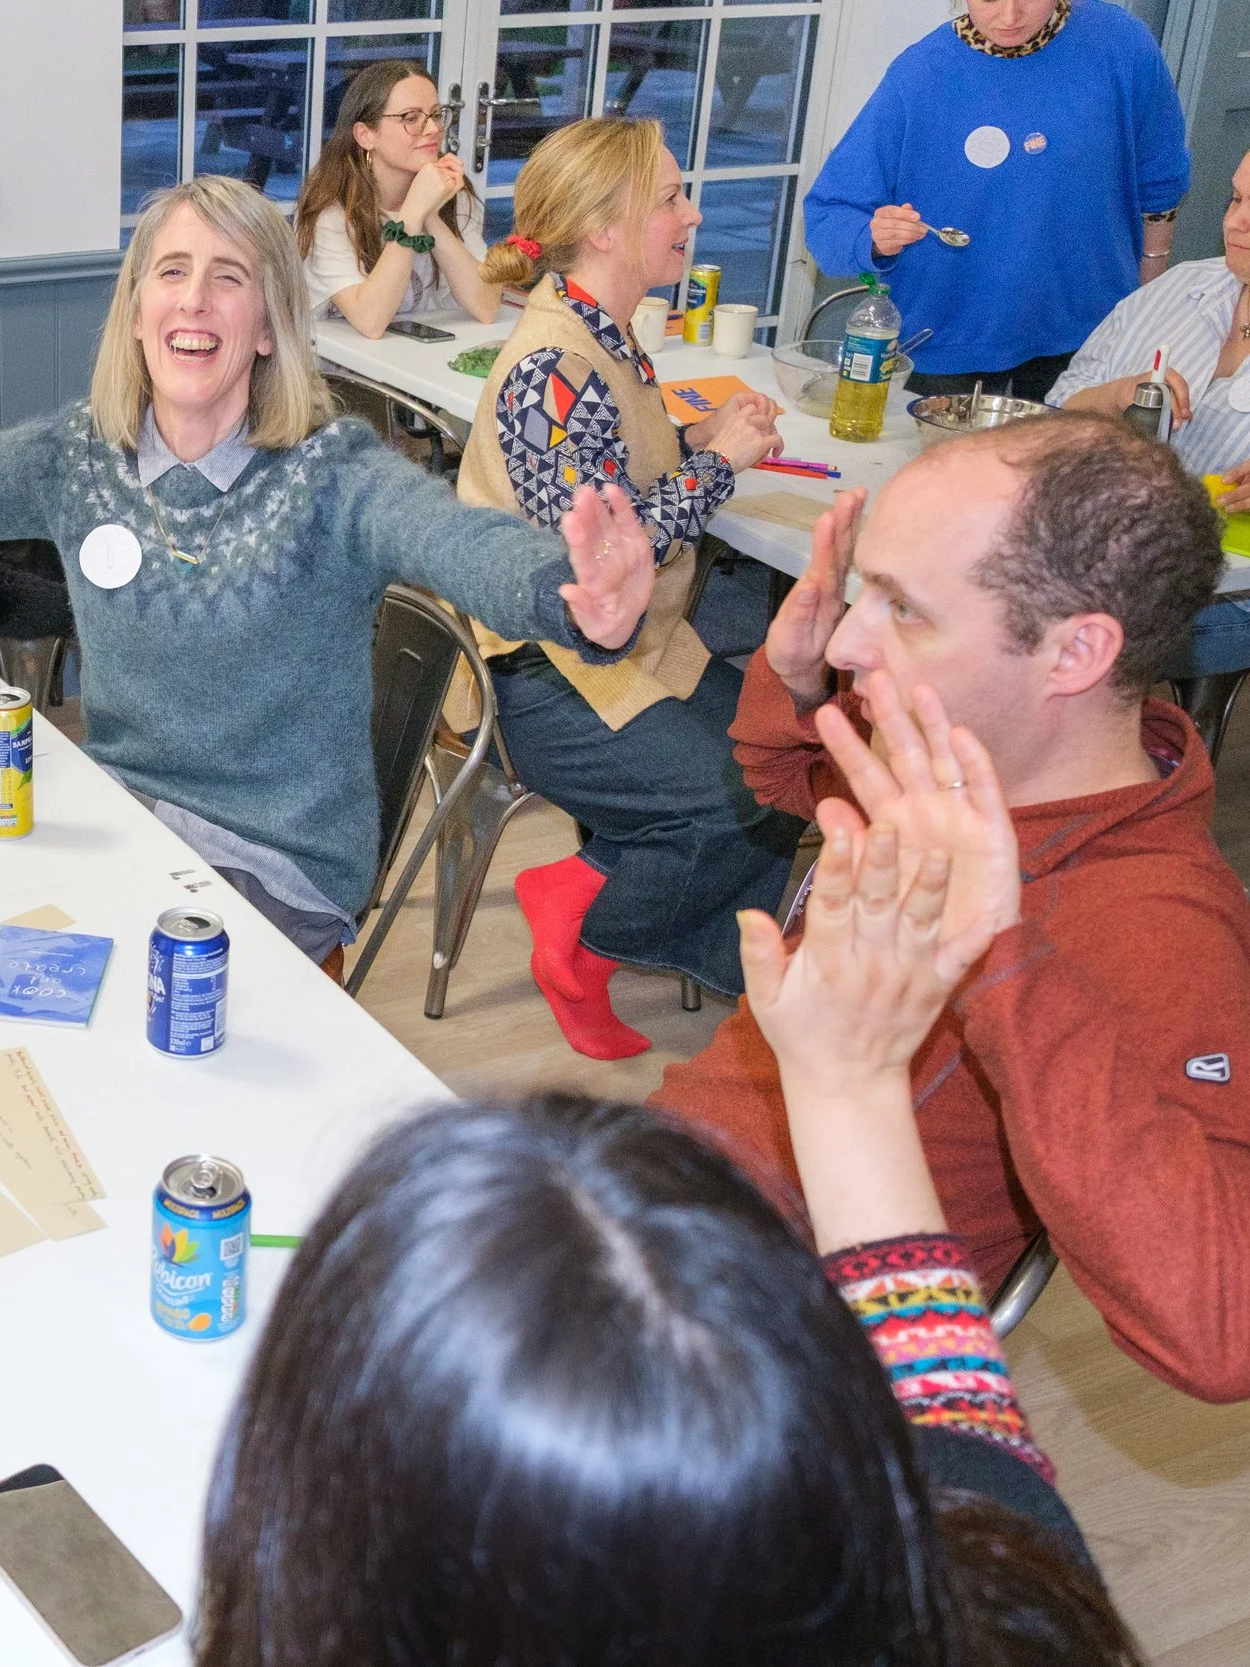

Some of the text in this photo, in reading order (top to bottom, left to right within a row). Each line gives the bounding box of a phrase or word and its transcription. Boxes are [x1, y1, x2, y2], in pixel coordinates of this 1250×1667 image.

[670, 387, 719, 412] FINE
[9, 961, 86, 976] create
[30, 975, 61, 985] and
[11, 984, 66, 998] cook
